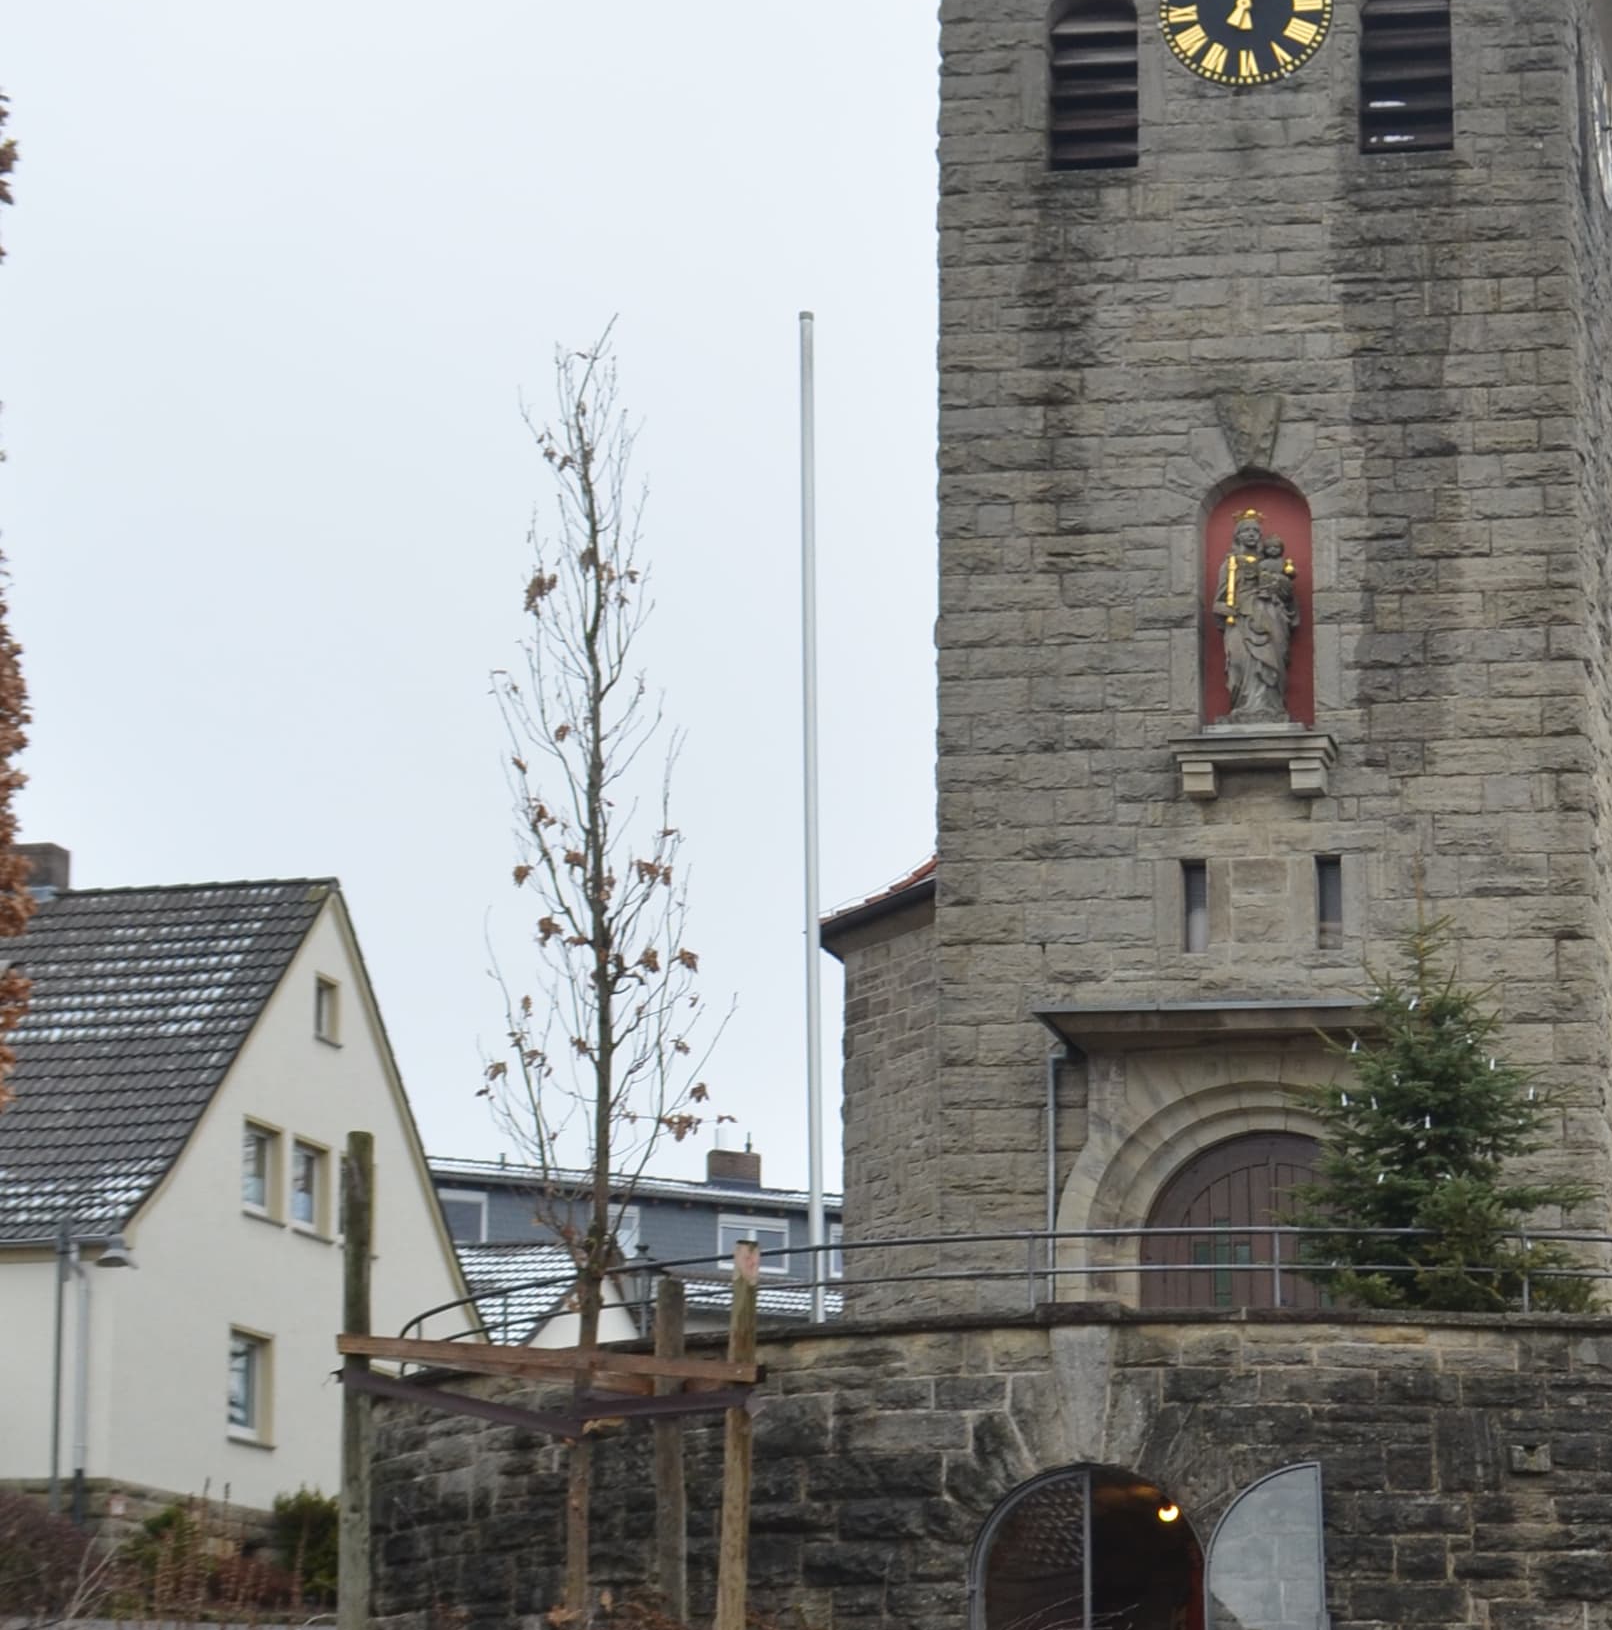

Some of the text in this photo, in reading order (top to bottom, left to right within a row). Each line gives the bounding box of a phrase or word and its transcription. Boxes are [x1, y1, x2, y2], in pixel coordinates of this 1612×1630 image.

[1169, 5, 1198, 23] IX
[1175, 24, 1209, 56] VIII
[1270, 41, 1293, 65] V
[1201, 42, 1228, 74] VII
[1239, 50, 1259, 76] VI
